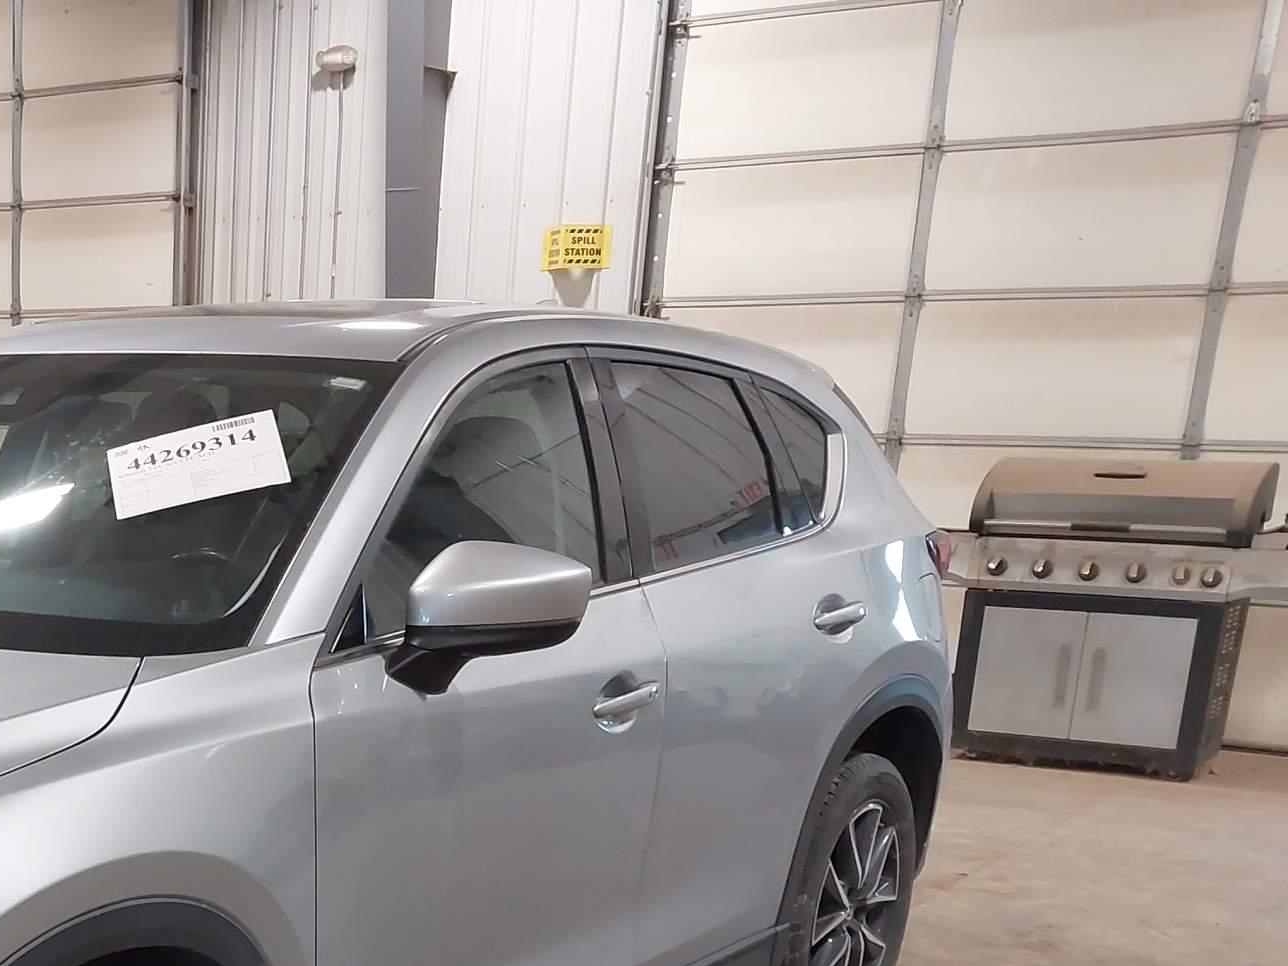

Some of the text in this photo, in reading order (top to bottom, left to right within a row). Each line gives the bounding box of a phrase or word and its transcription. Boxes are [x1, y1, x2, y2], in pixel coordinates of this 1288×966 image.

[571, 236, 596, 245] SPILL
[563, 247, 602, 256] STATION
[127, 428, 257, 470] 44269314
